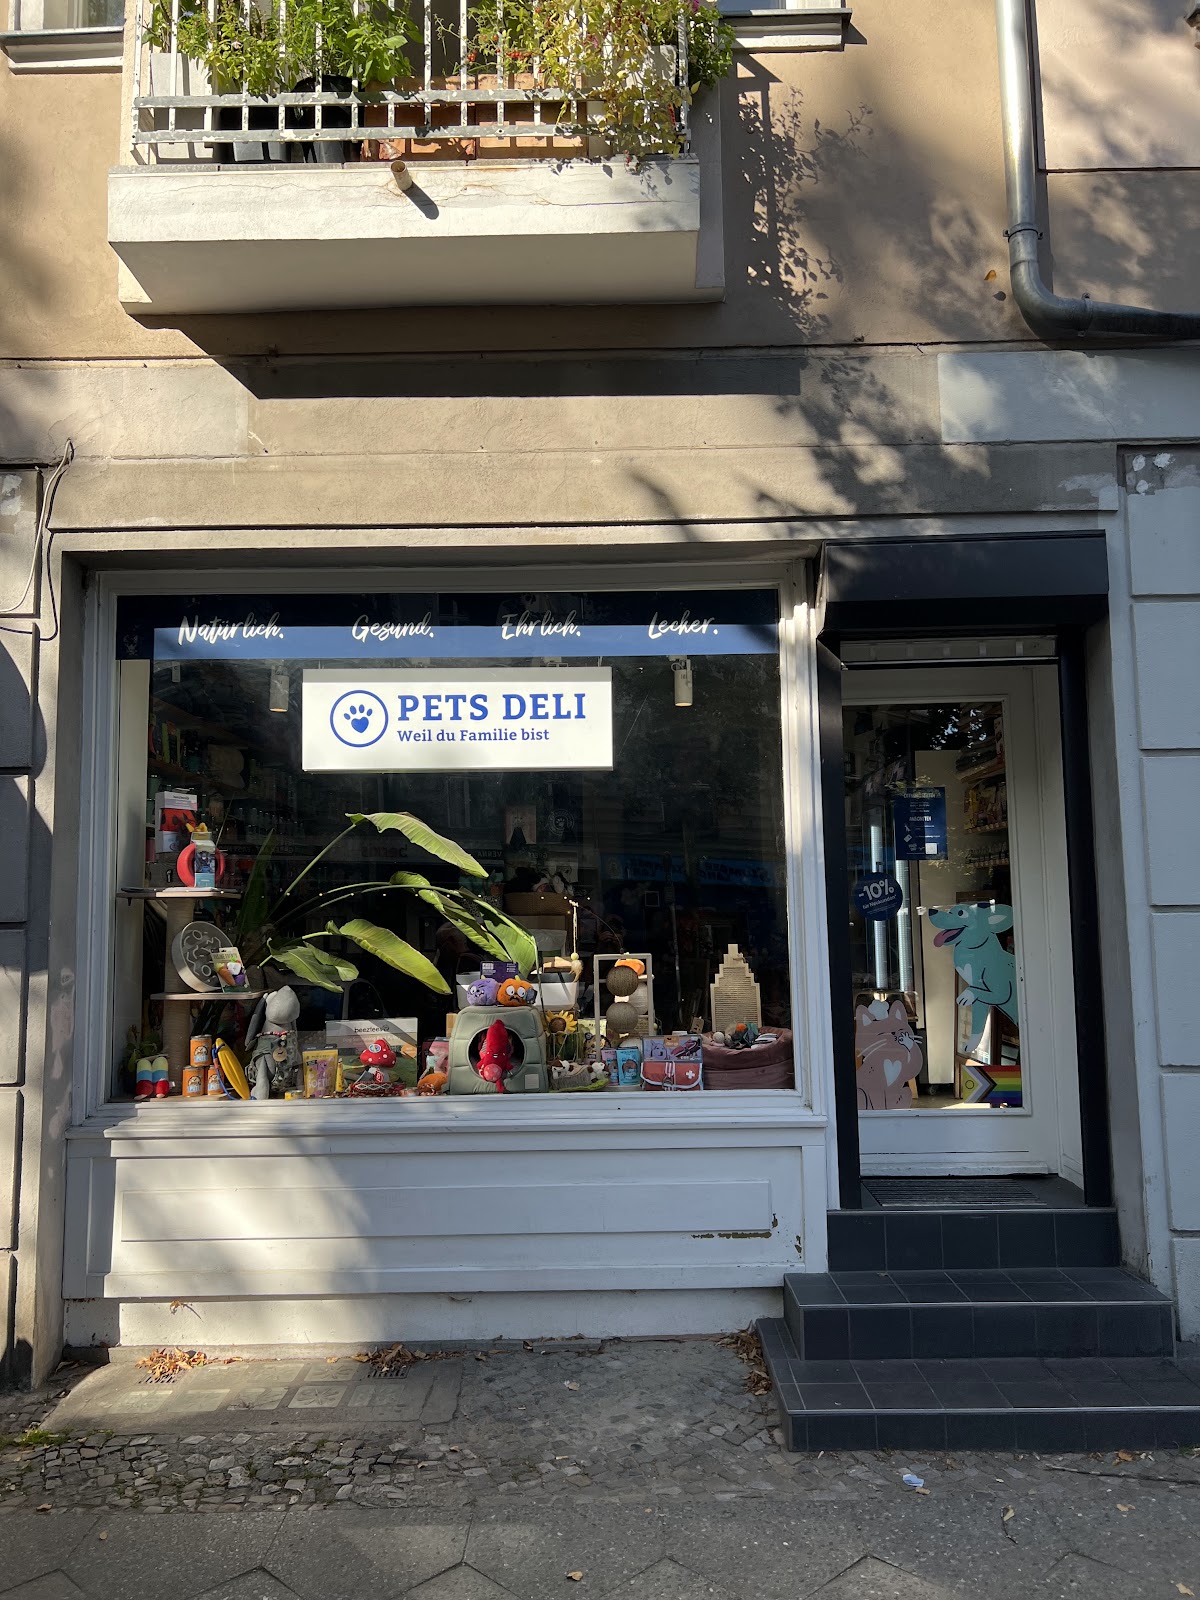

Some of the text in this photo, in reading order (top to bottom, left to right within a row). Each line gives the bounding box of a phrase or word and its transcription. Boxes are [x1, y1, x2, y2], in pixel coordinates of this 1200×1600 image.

[177, 611, 285, 646] Natürlich.
[351, 611, 434, 642] Gesund.
[501, 609, 582, 641] Ehrlich.
[397, 693, 586, 721] PETS DELI
[397, 728, 550, 742] Weil du Familie bist
[858, 878, 895, 901] -10%
